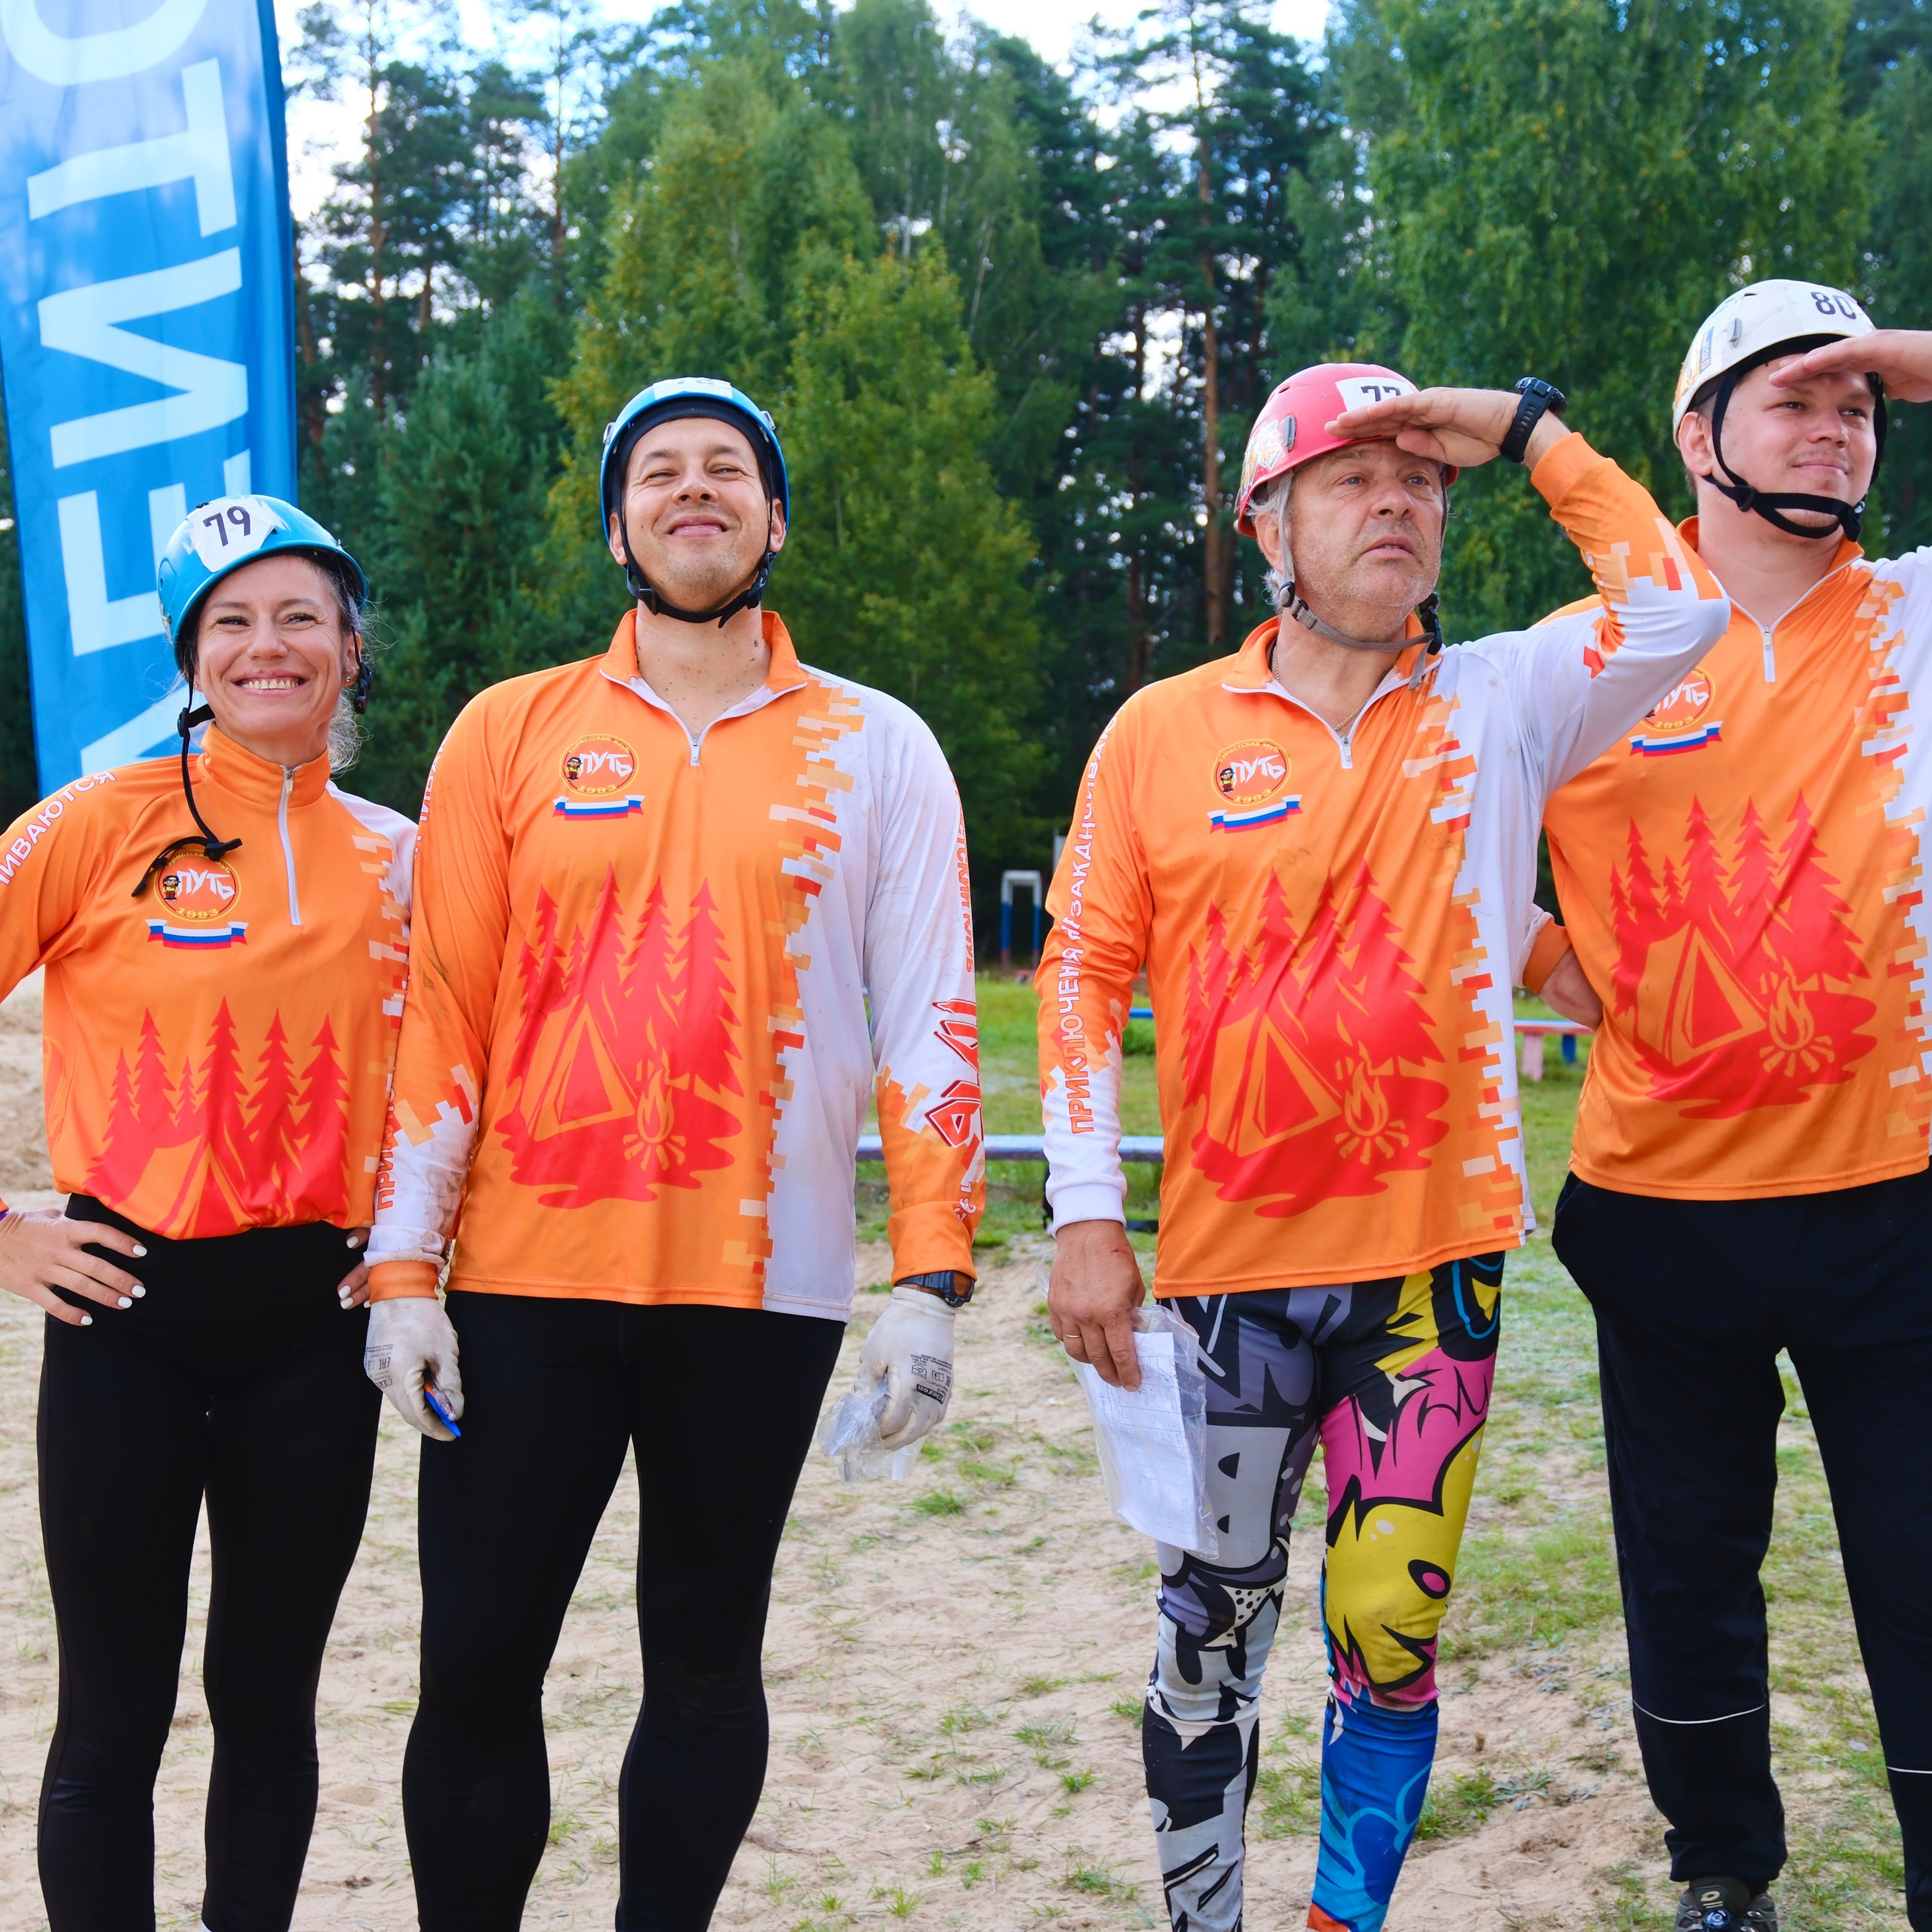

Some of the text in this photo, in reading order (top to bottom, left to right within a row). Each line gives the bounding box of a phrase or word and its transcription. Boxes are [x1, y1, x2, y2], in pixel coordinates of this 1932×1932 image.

[1810, 291, 1857, 320] 80
[1361, 385, 1401, 401] 77
[202, 505, 251, 546] 79
[1656, 715, 1694, 728] 1993
[579, 750, 633, 777] ПУТЬ
[1230, 755, 1287, 788] ПУТЬ
[578, 783, 617, 794] 1993
[1233, 788, 1272, 803] 1993
[176, 867, 235, 900] ПУТЬ
[176, 907, 220, 918] 1993
